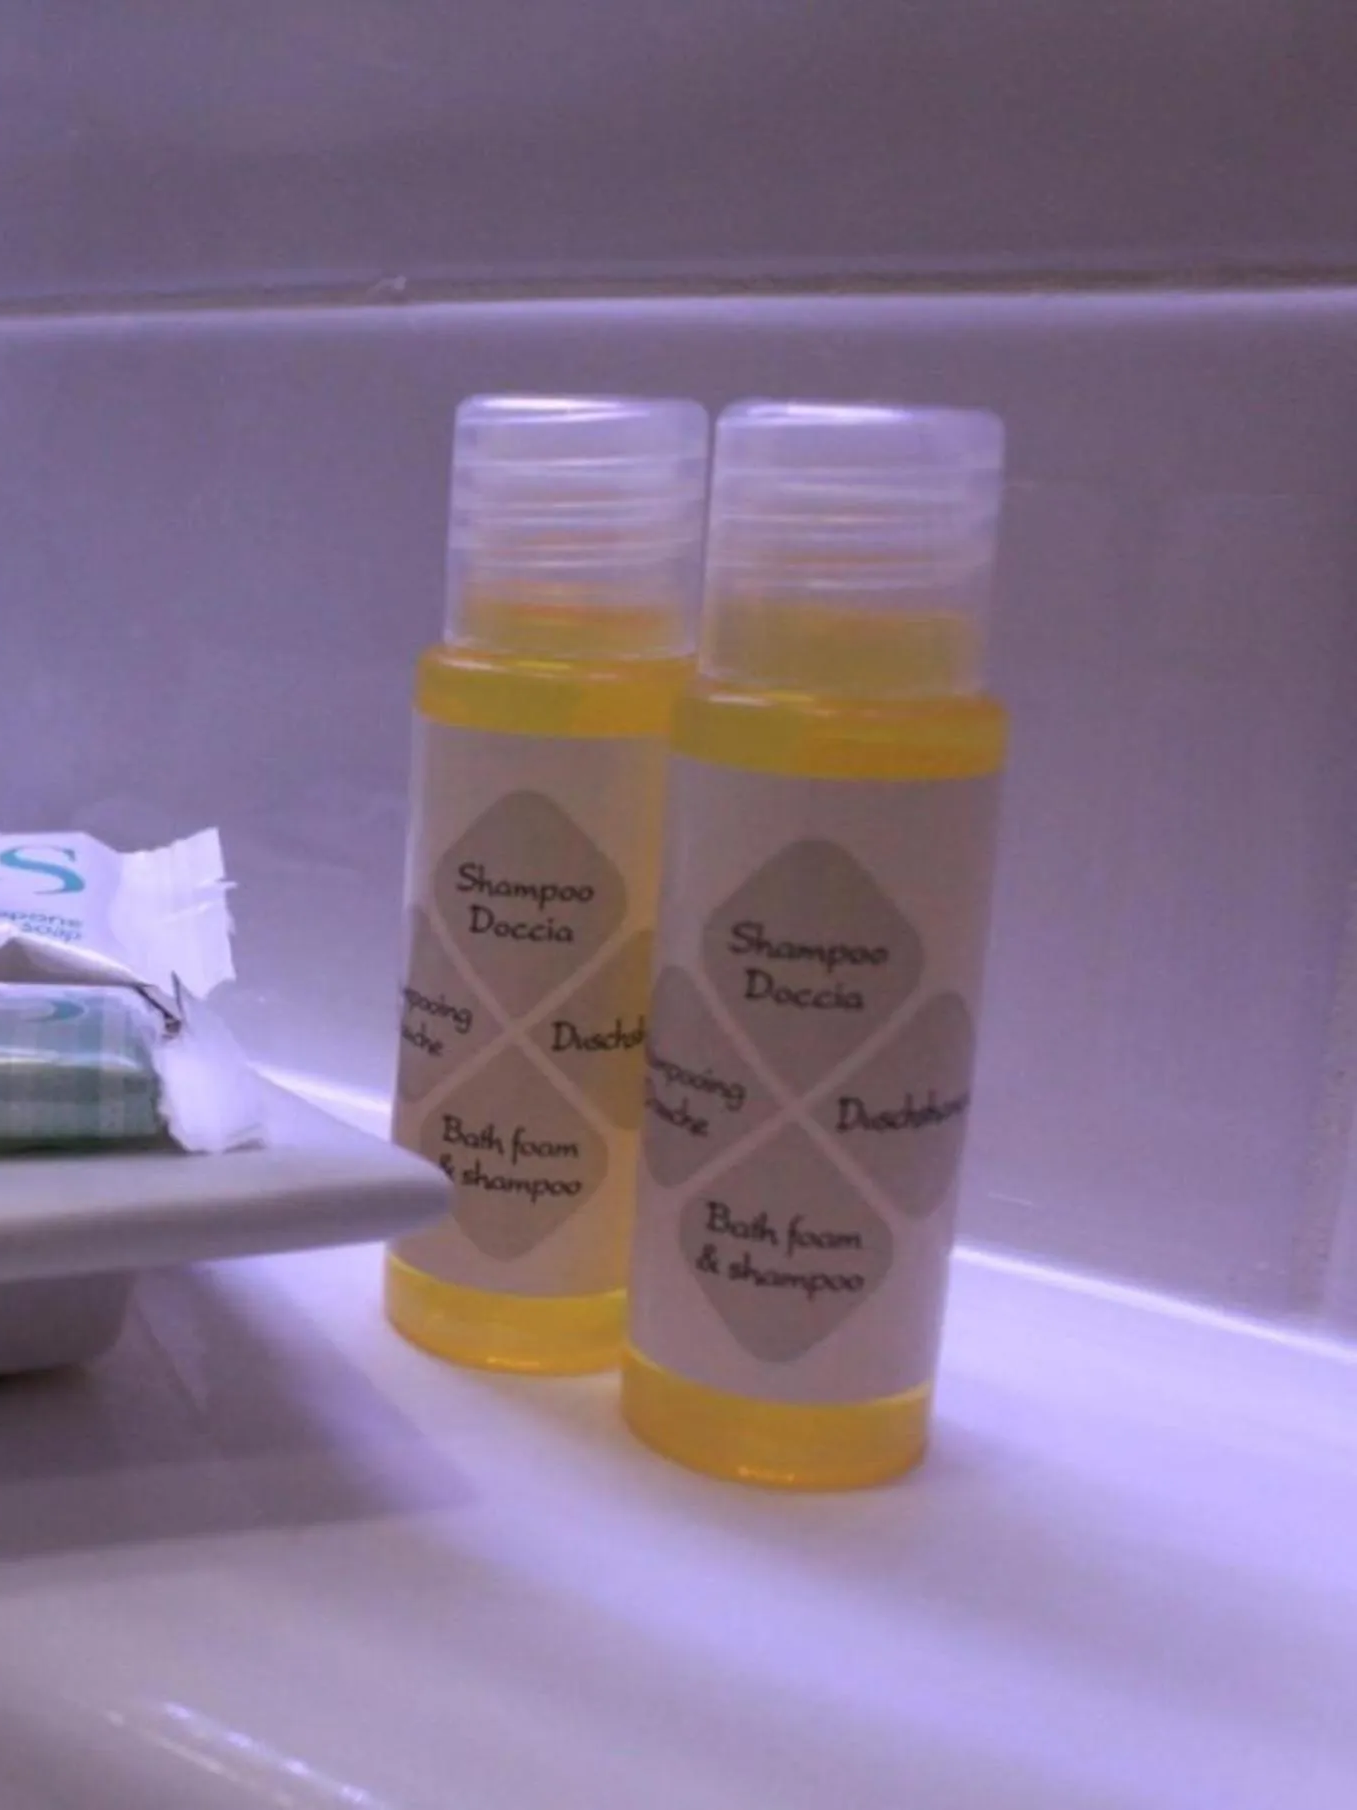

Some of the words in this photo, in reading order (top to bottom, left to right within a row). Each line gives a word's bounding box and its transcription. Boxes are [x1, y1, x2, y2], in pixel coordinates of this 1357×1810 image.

[456, 861, 595, 909] Shampoo
[468, 904, 574, 943] Doccia
[726, 920, 889, 974] Shampoo
[402, 987, 474, 1035] pooing
[742, 967, 866, 1010] Doccia
[442, 1114, 505, 1155] Bath
[510, 1125, 579, 1165] foam
[461, 1157, 583, 1205] shampoo
[704, 1200, 778, 1249] Bath
[785, 1215, 862, 1257] foam
[694, 1245, 720, 1276] &
[727, 1253, 866, 1299] shampoo
